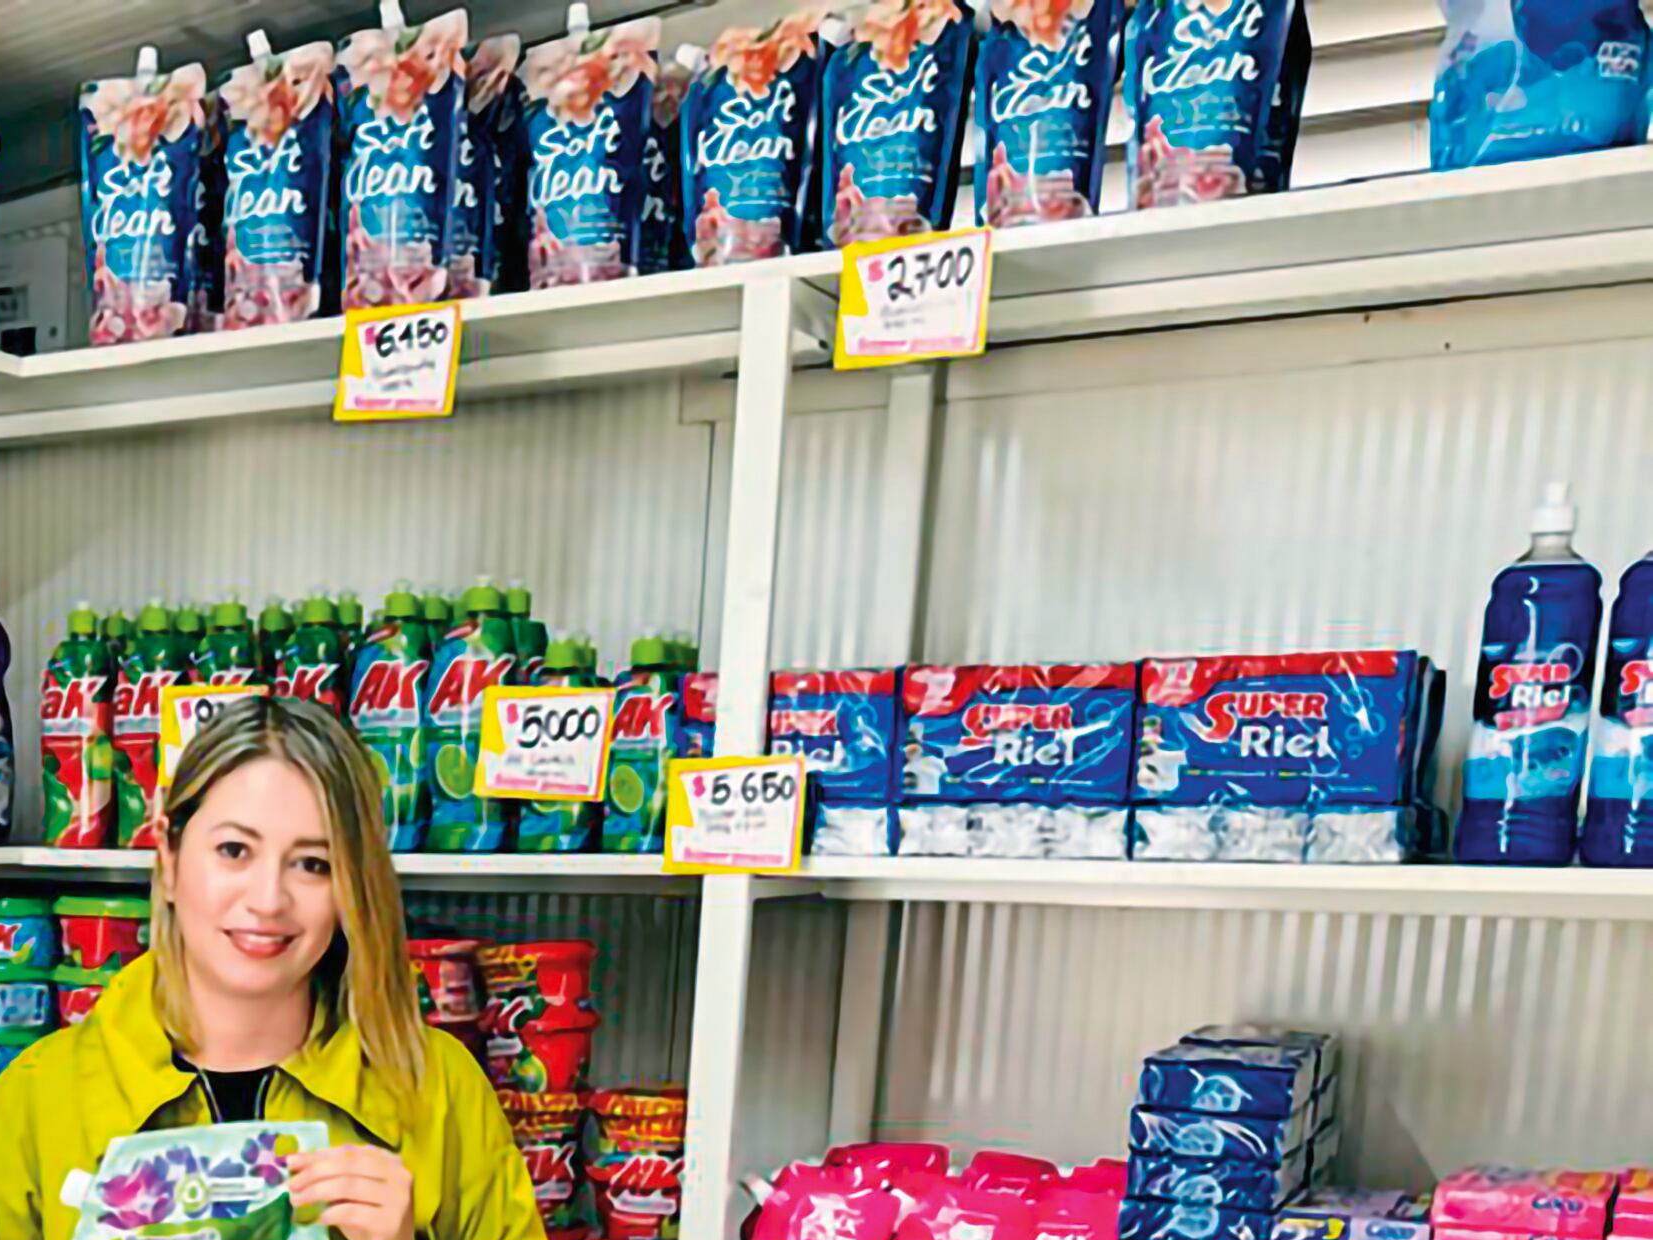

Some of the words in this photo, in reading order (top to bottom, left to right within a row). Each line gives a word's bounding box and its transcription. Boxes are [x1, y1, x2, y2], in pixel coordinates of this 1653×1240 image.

[854, 53, 939, 103] Soft
[352, 104, 434, 155] Soft
[713, 81, 797, 130] Soft
[534, 107, 622, 163] Soft
[351, 660, 429, 716] AK
[611, 694, 674, 742] AK
[1240, 724, 1336, 759] Riel
[994, 735, 1075, 767] Riel
